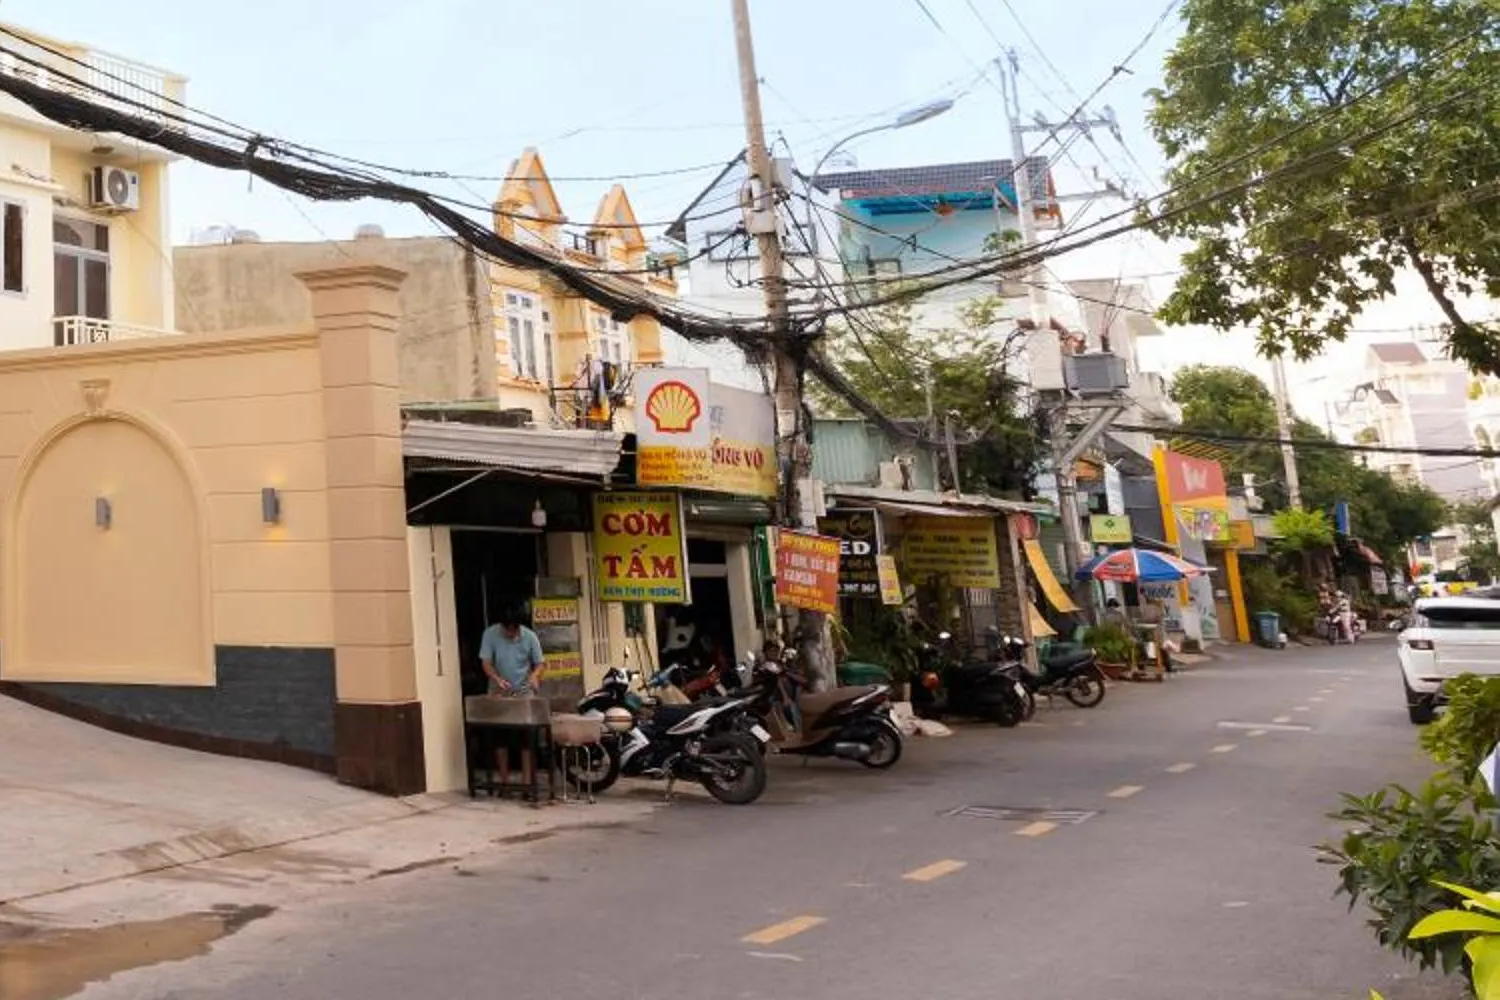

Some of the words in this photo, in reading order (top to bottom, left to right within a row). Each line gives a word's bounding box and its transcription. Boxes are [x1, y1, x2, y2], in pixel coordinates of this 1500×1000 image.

[602, 508, 672, 537] CƠM
[602, 543, 677, 579] TẤM
[839, 541, 871, 556] ED
